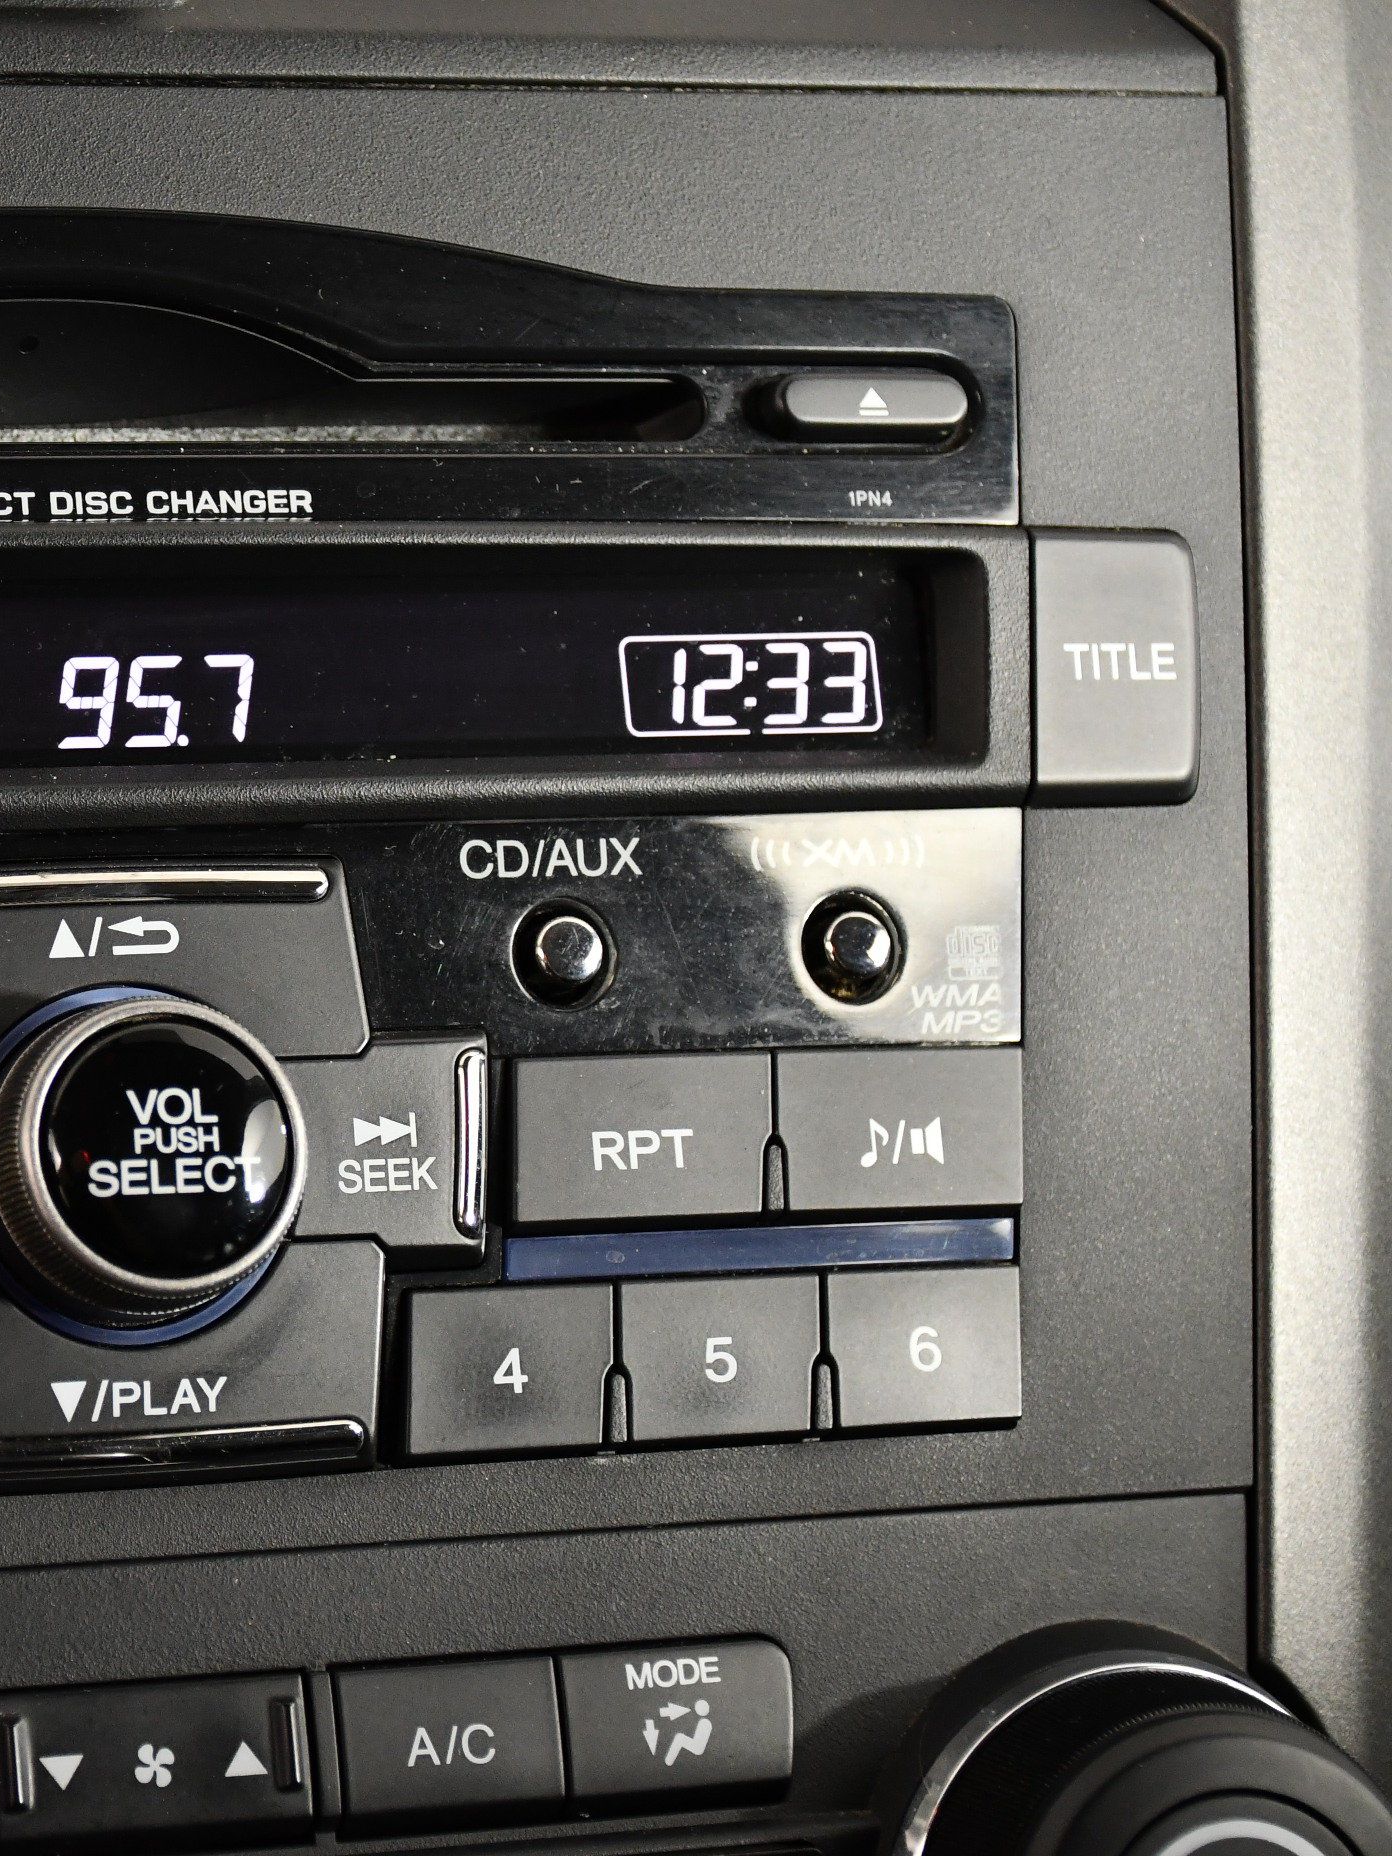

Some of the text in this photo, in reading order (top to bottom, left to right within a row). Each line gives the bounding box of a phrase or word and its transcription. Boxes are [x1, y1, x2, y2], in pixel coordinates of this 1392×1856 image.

[49, 490, 134, 516] DISC
[146, 489, 314, 515] CHANGER
[848, 489, 893, 508] 1PN4
[1062, 642, 1178, 681] TITLE
[57, 653, 255, 749] 95.7
[671, 641, 868, 727] 12:33
[459, 837, 644, 880] CD/AUX
[911, 982, 1002, 1008] WMA
[921, 1009, 1004, 1035] MP3
[125, 1087, 219, 1126] VOL
[133, 1126, 221, 1154] PUSH
[591, 1128, 694, 1171] RPT
[88, 1155, 261, 1198] SELECT
[338, 1156, 439, 1194] SEEK
[705, 1336, 738, 1383] 5
[909, 1325, 942, 1372] 6
[492, 1347, 529, 1394] 4
[624, 1656, 722, 1691] MODE
[407, 1723, 496, 1768] A/C
